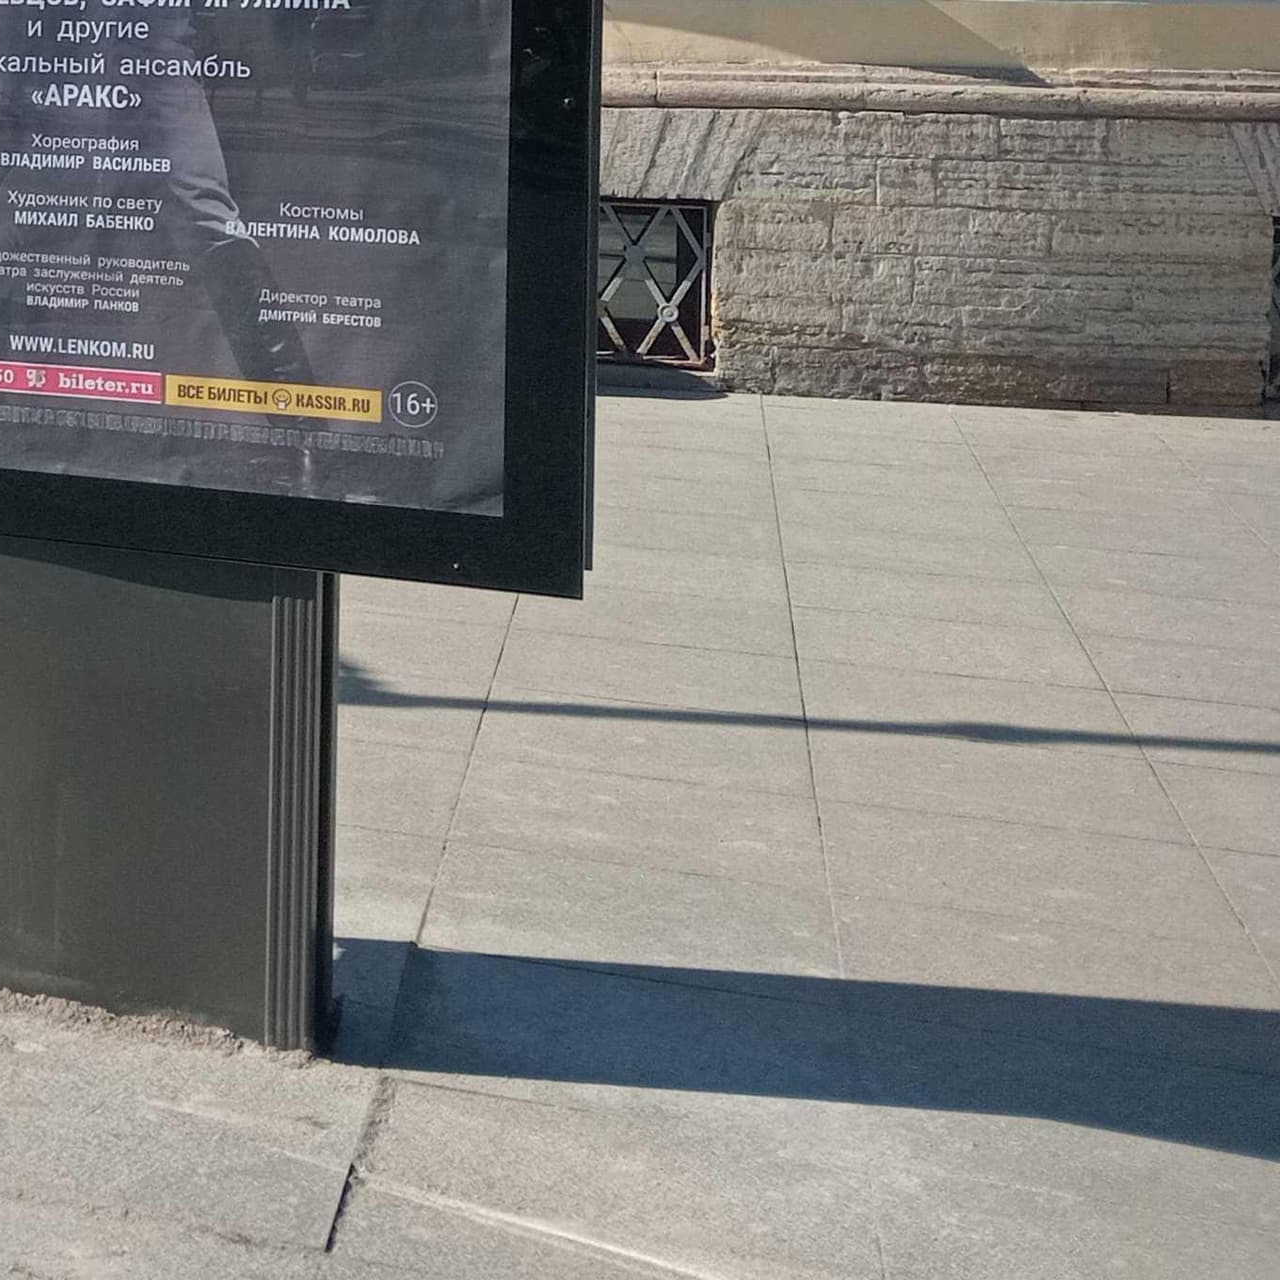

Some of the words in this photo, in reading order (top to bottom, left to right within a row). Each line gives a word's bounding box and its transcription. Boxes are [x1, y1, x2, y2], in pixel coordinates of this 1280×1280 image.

[27, 21, 42, 37] и
[57, 19, 150, 43] другие
[120, 54, 251, 79] ансамбль
[31, 84, 142, 109] «АРАКС»
[31, 133, 139, 153] Хореография
[0, 152, 85, 170] ВЛАДИМИР
[92, 156, 171, 173] ВАСИЛЬЕВ
[7, 190, 89, 208] Художник
[92, 196, 112, 208] по
[116, 198, 163, 214] свету
[280, 202, 364, 221] Костюмы
[14, 210, 78, 227] МИХАИЛ
[86, 214, 154, 231] БАБЕНКО
[225, 220, 320, 240] ВАЛЕНТИНА
[328, 225, 421, 246] КОМОЛОВА
[97, 256, 190, 272] руководитель
[33, 269, 124, 283] заслуженный
[129, 273, 184, 287] деятель
[26, 282, 85, 296] искусств
[91, 284, 140, 298] России
[259, 288, 328, 307] Директор
[334, 295, 382, 310] театра
[26, 295, 89, 310] ВЛАДИМИР
[94, 299, 140, 313] ПАНКОВ
[258, 308, 317, 323] ДМИТРИЙ
[322, 312, 382, 328] БЕРЕСТОВ
[9, 334, 156, 361] WWW.LENKOM.RU
[58, 372, 154, 395] bileter.ru
[177, 383, 203, 399] ВСЕ
[207, 386, 268, 404] БИЛЕТЫ
[296, 393, 371, 413] KASSIR.RU
[392, 392, 435, 415] 16+
